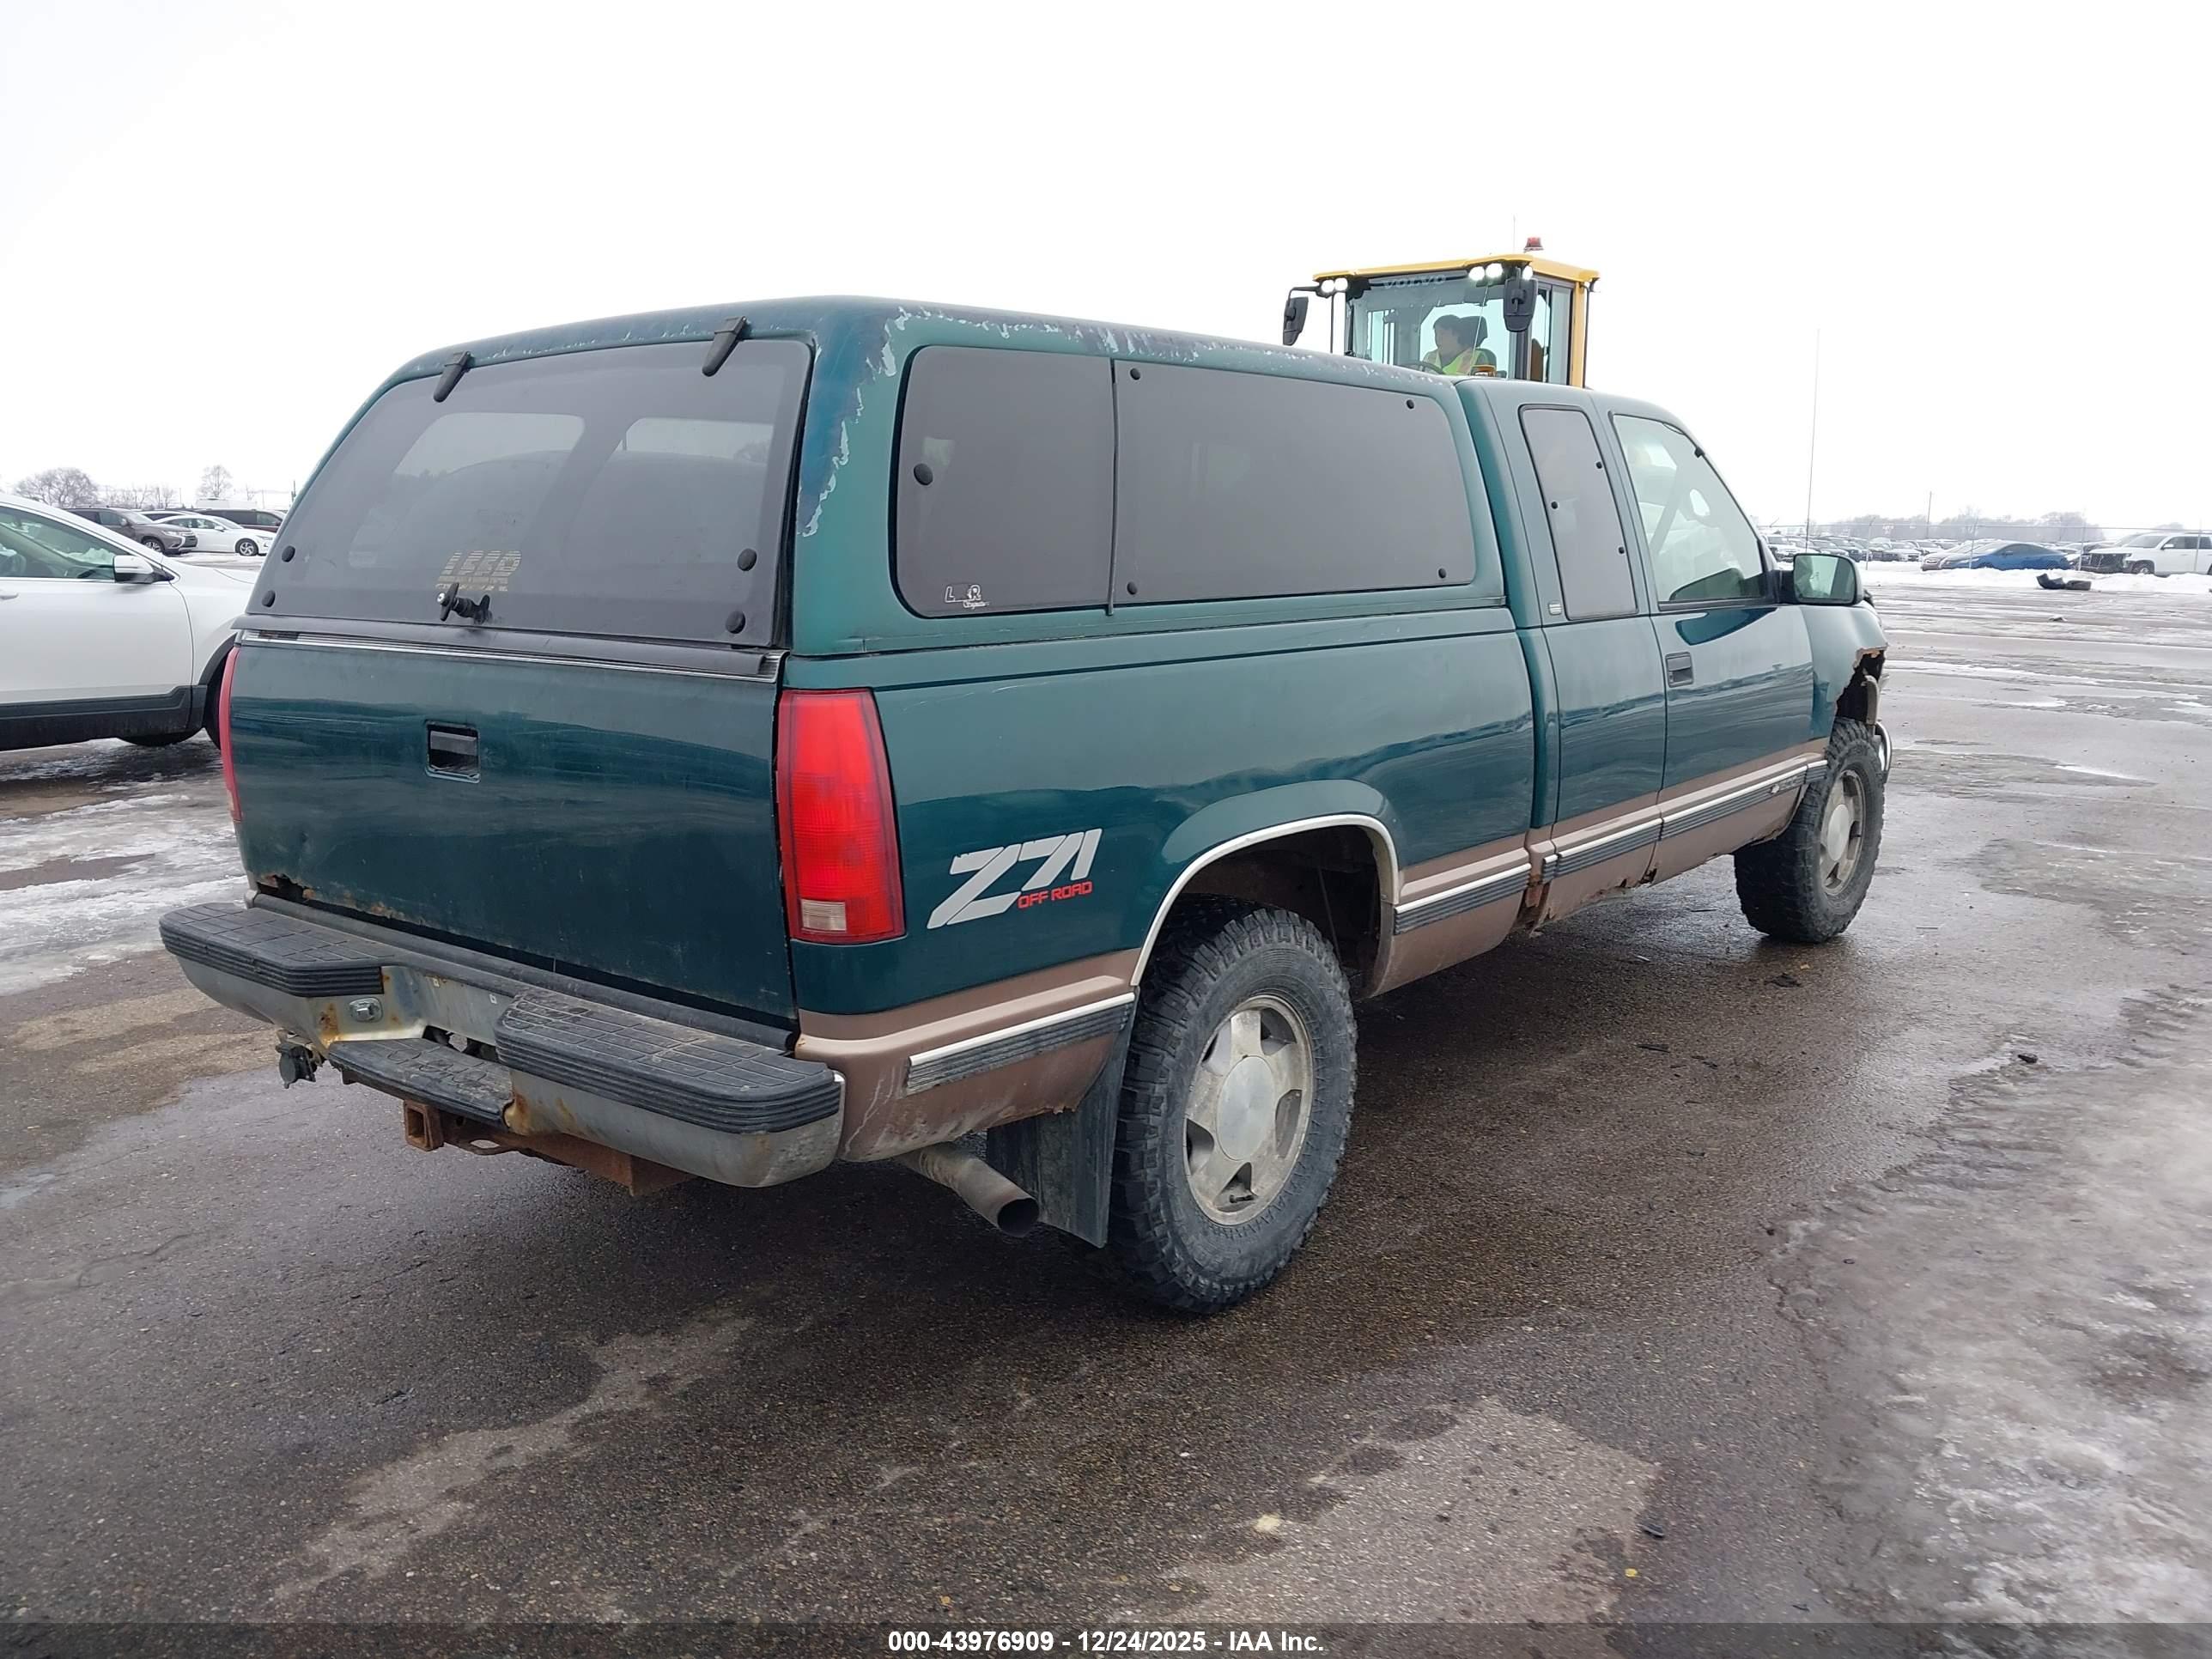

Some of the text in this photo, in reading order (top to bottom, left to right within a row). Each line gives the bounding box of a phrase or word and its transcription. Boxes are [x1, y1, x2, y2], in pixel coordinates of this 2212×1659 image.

[1384, 276, 1445, 289] VOLVO
[927, 828, 1103, 929] Z71
[1018, 881, 1092, 908] OFF ROAD
